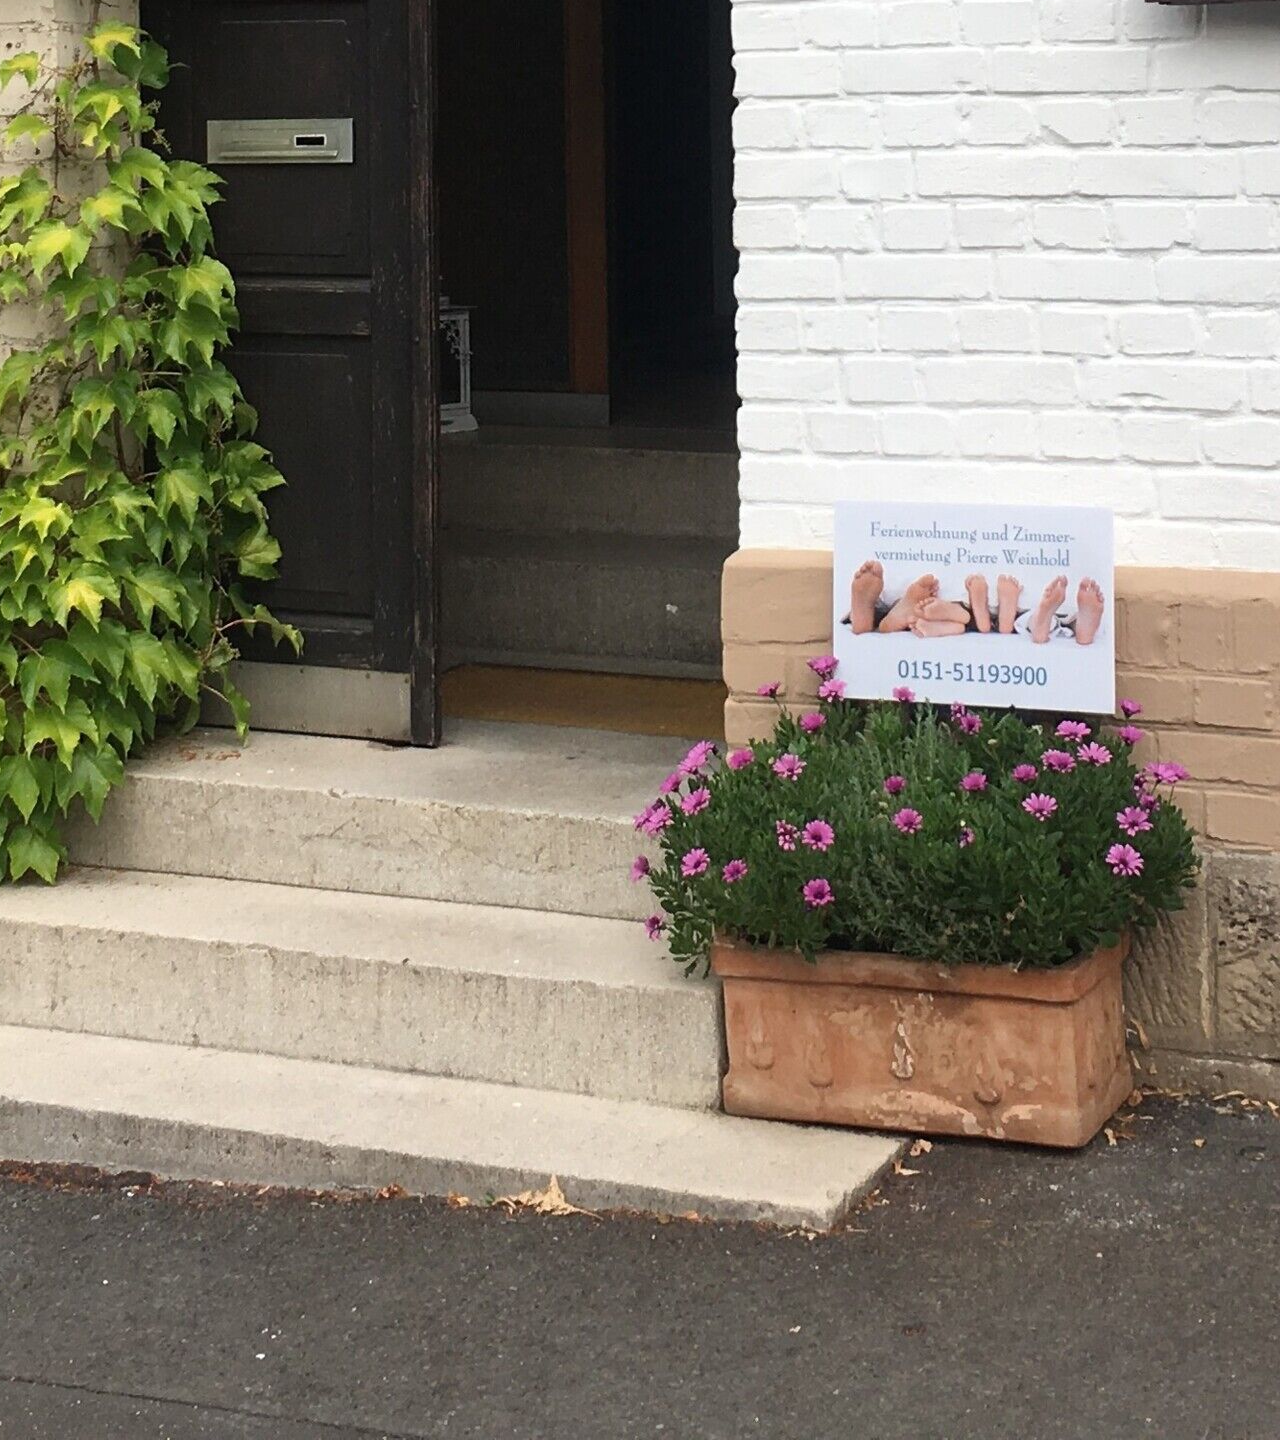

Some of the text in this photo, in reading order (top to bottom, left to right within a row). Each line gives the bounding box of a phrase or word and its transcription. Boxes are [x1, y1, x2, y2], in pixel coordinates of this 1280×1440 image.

[870, 521, 1075, 544] Ferienwohnung und Zimmer-
[874, 548, 1071, 567] vermietung Pierre Weinhold
[898, 659, 1048, 686] 0151-51193900
